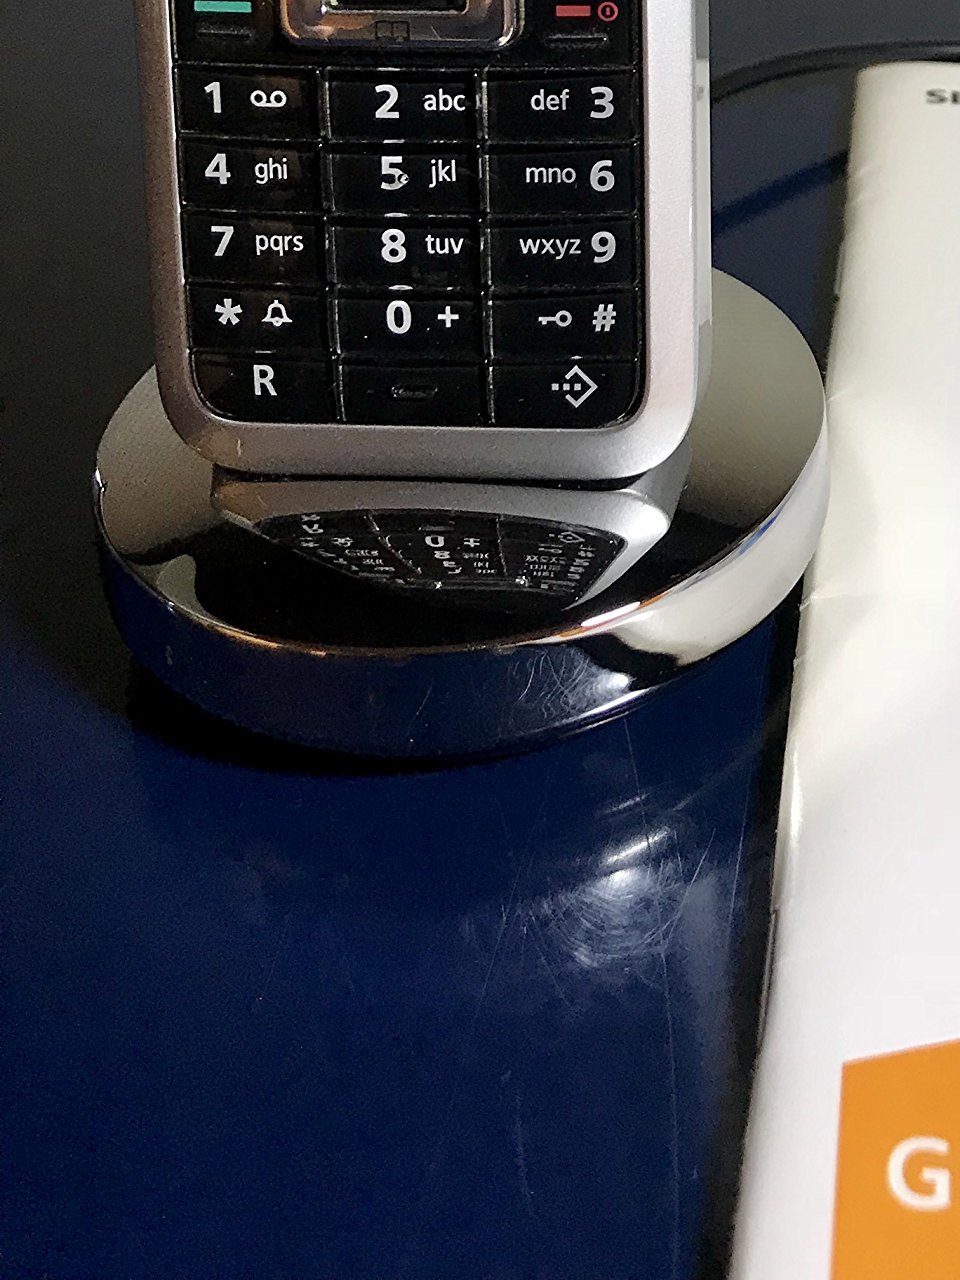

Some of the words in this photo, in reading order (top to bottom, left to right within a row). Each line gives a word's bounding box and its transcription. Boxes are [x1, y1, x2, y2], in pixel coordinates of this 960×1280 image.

[204, 82, 223, 114] 1
[374, 84, 400, 120] 2
[422, 91, 466, 113] abc
[530, 89, 570, 112] def
[589, 86, 615, 120] 3
[204, 153, 231, 185] 4
[254, 158, 289, 186] ghi
[380, 156, 405, 190] 5
[428, 159, 457, 188] jkl
[525, 166, 577, 185] mno
[589, 160, 615, 193] 6
[210, 226, 234, 257] 7
[255, 234, 304, 257] pqrs
[380, 228, 407, 263] 8
[425, 235, 465, 255] tuv
[519, 238, 582, 258] wxyz
[590, 231, 616, 263] 9
[386, 299, 412, 334] 0
[592, 303, 617, 332] #
[252, 364, 278, 396] R
